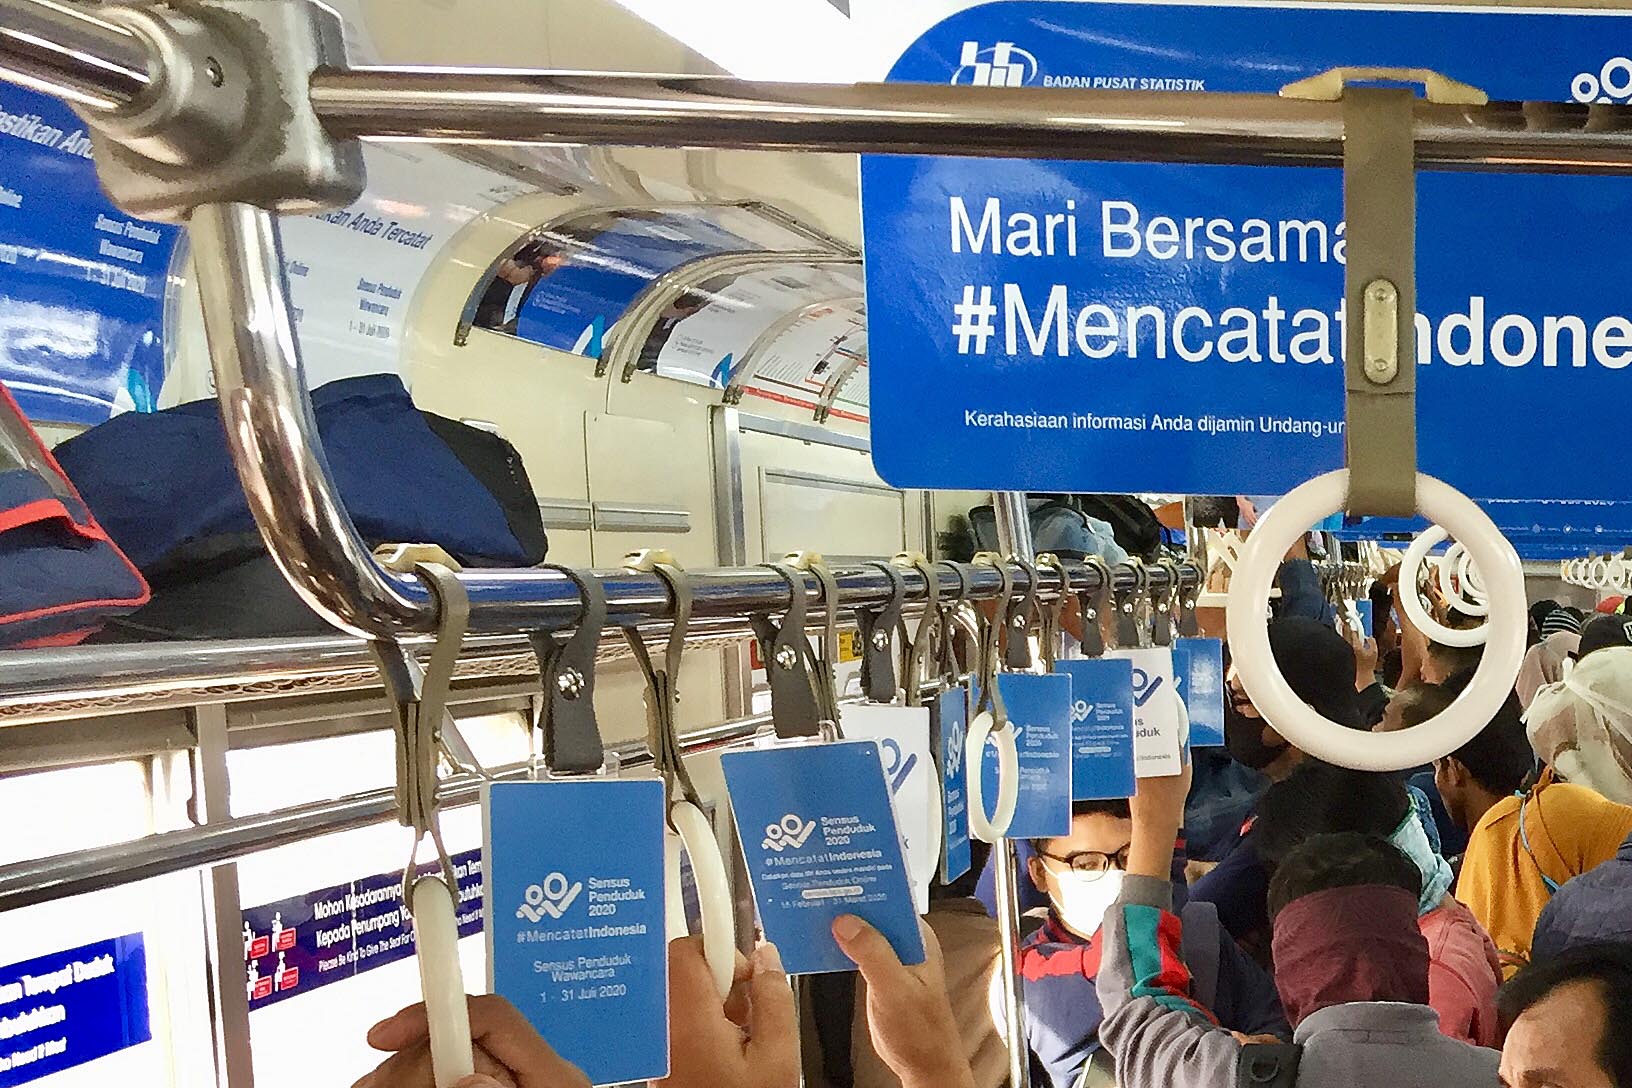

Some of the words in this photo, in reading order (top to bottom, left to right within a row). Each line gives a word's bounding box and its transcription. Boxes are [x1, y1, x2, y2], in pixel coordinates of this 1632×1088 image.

[1043, 76, 1092, 88] BADAN
[1094, 77, 1136, 90] PUSAT
[1140, 78, 1206, 91] STATISTIK
[0, 105, 63, 148] astikan
[350, 212, 383, 236] Anda
[381, 221, 433, 250] Tercatat
[949, 196, 1077, 256] Mari
[964, 409, 1068, 428] Kerahasiaan
[1072, 412, 1147, 430] informasi
[1151, 414, 1193, 431] Anda
[1198, 415, 1255, 435] dijamin
[821, 816, 860, 826] Sensus
[823, 824, 876, 836] Penduduk
[825, 835, 850, 846] 2020
[588, 877, 630, 889] Sensus
[589, 889, 645, 903] Penduduk
[314, 899, 345, 920] Mohon
[588, 903, 616, 917] 2020
[316, 924, 350, 948] Kepada
[517, 923, 647, 943] #MencatatIndonesia
[534, 960, 575, 973] Sensus
[578, 953, 632, 969] Penduduk
[551, 967, 615, 982] Wawancara
[562, 989, 574, 1001] 31
[600, 984, 626, 998] 2020
